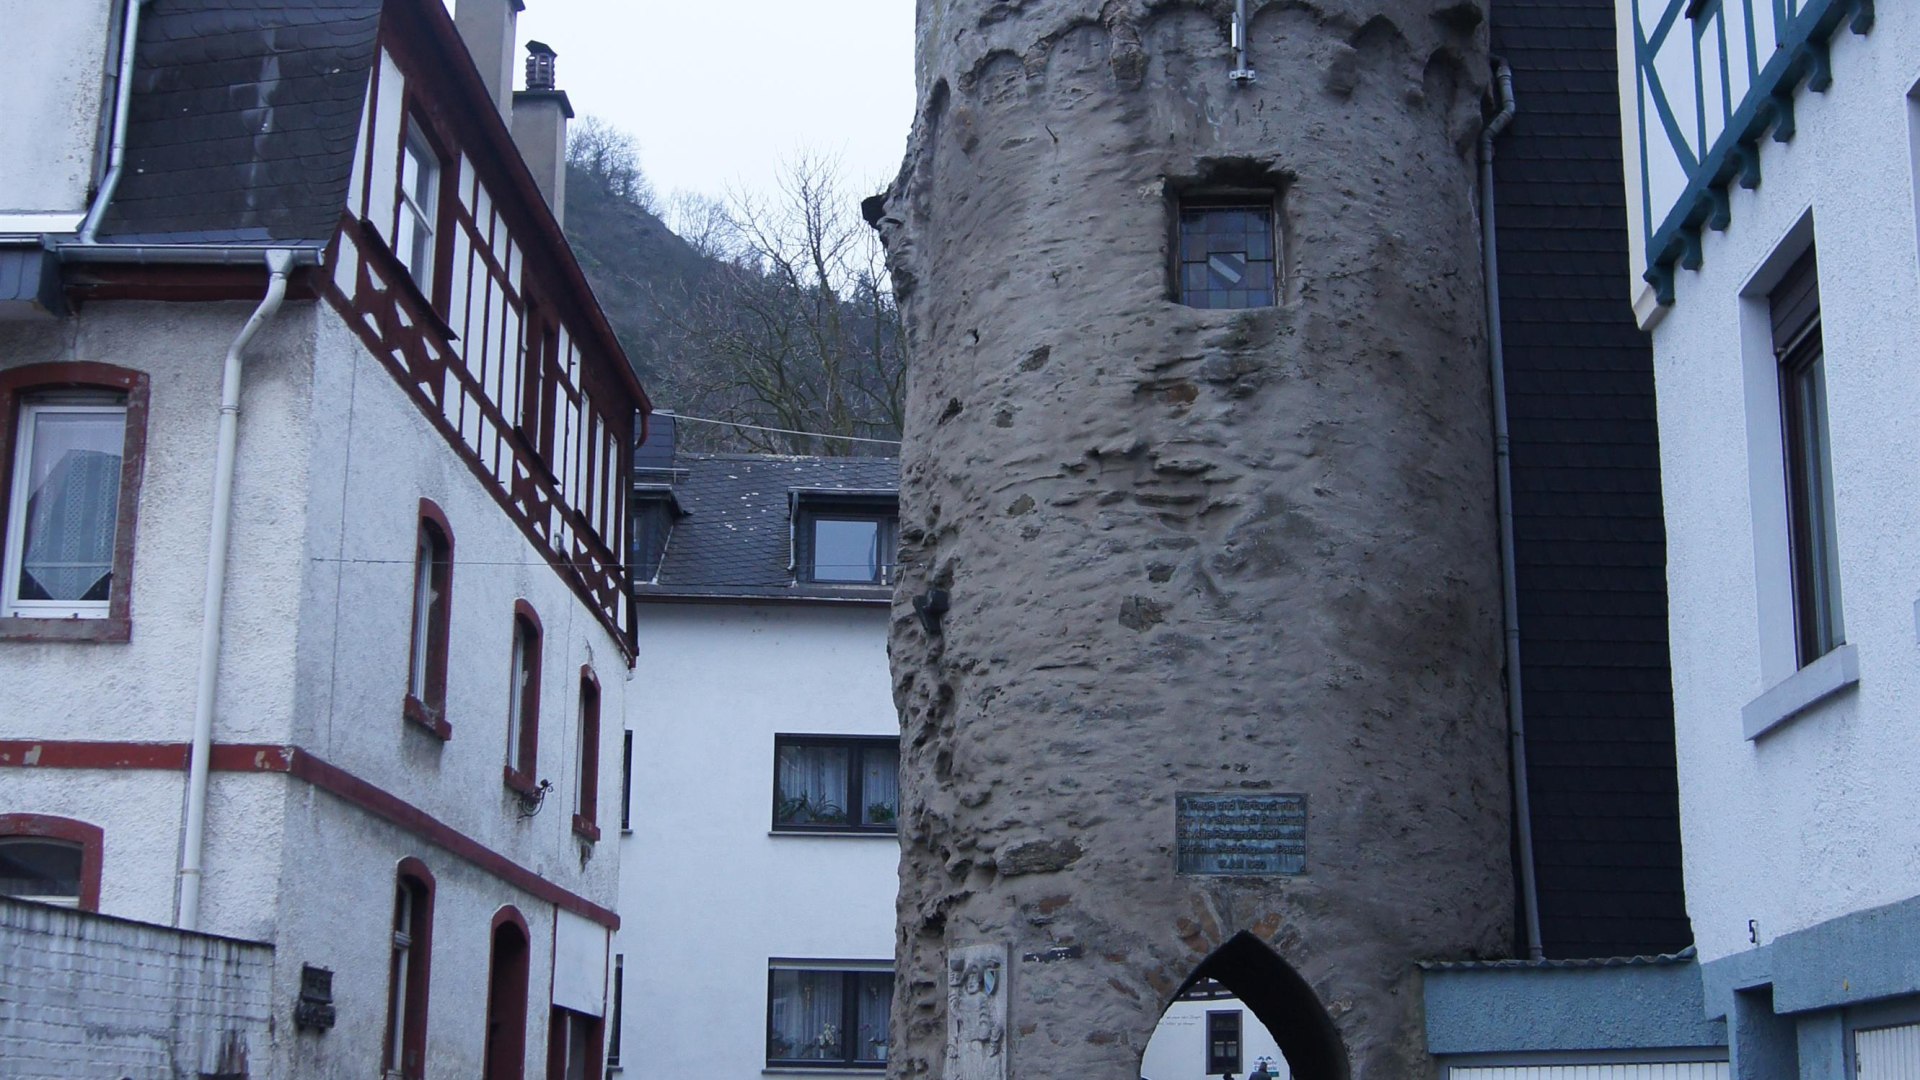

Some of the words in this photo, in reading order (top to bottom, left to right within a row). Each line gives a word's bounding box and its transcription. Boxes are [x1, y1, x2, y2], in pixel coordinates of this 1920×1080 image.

[1188, 799, 1216, 811] Treue
[1217, 799, 1236, 811] und
[1749, 919, 1757, 943] 5
